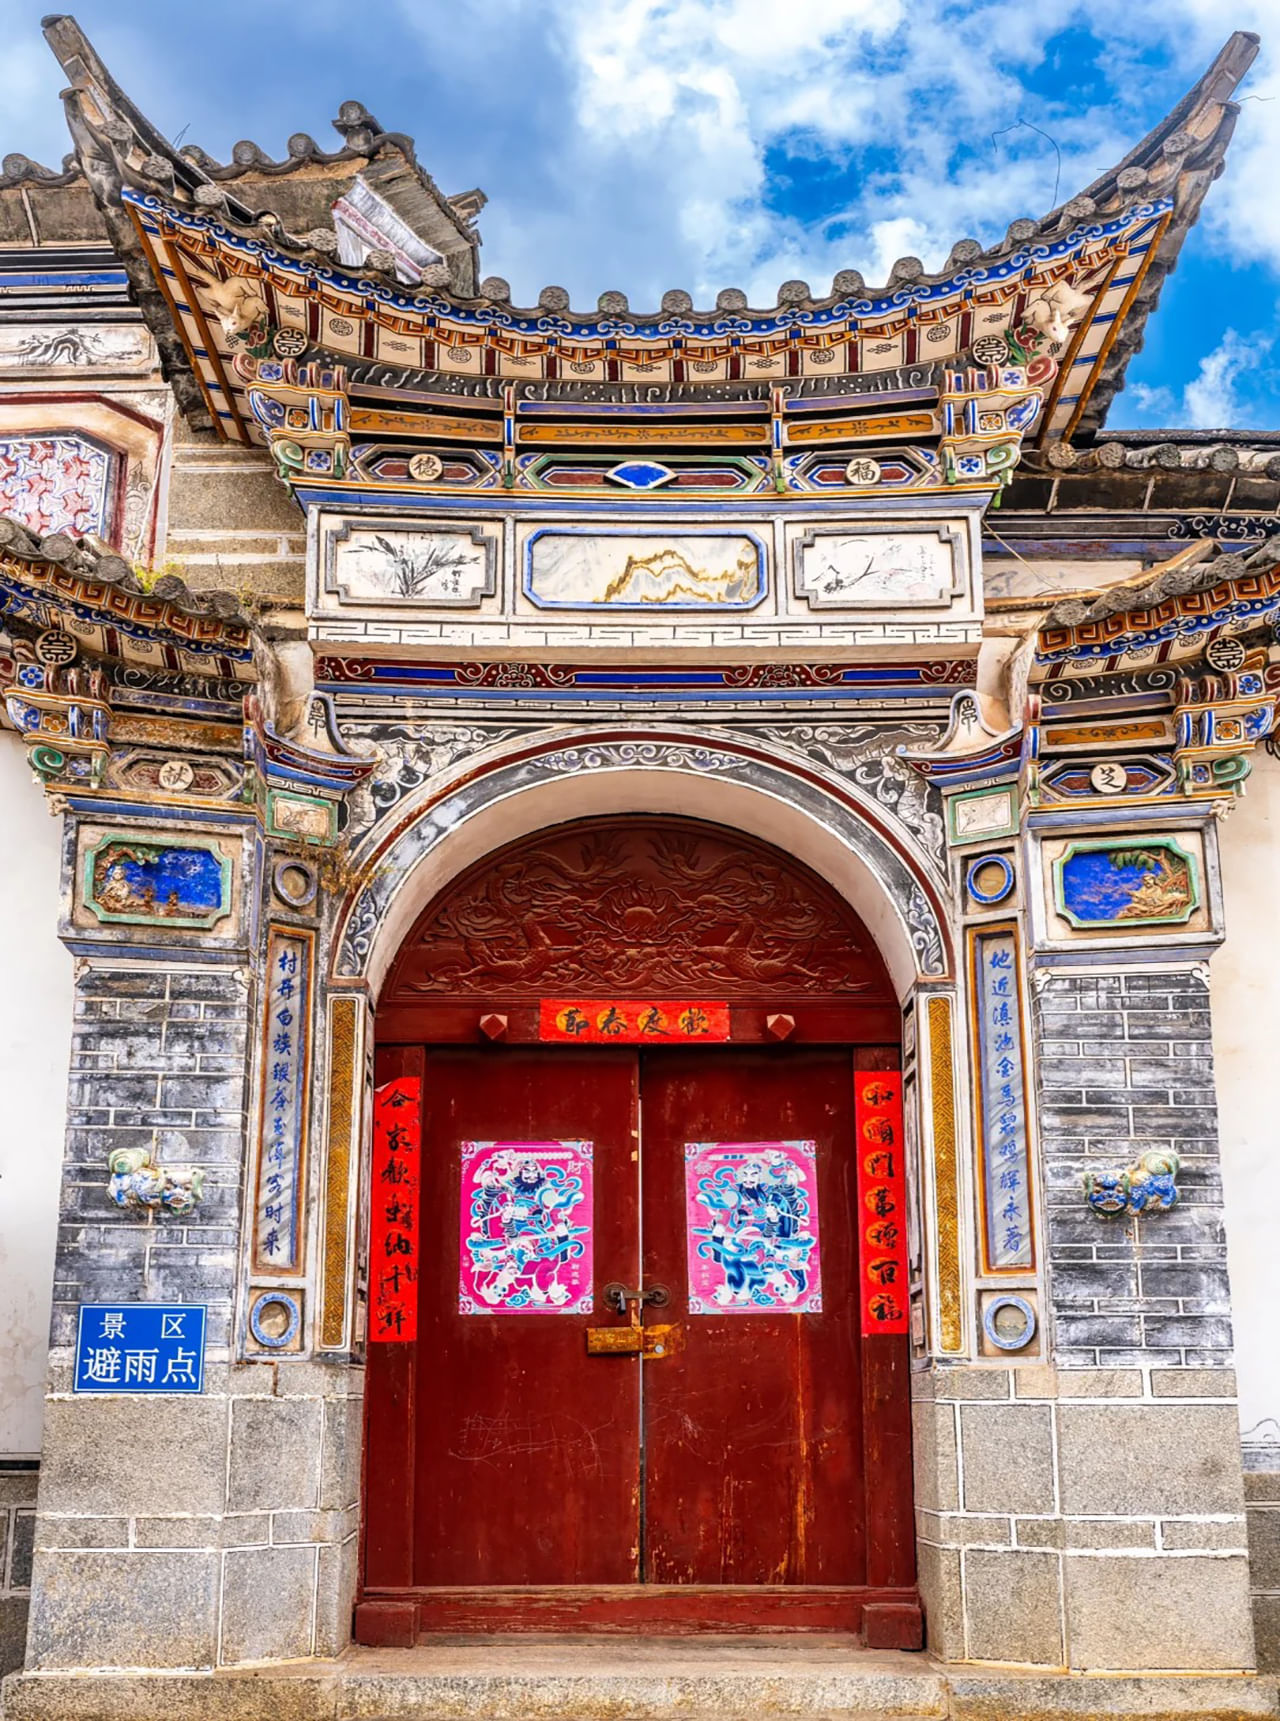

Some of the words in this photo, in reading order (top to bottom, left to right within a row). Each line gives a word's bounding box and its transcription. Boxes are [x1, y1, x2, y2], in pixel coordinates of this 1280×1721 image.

[850, 460, 876, 483] 福
[98, 1312, 187, 1340] 景区
[82, 1346, 197, 1383] 避雨点
